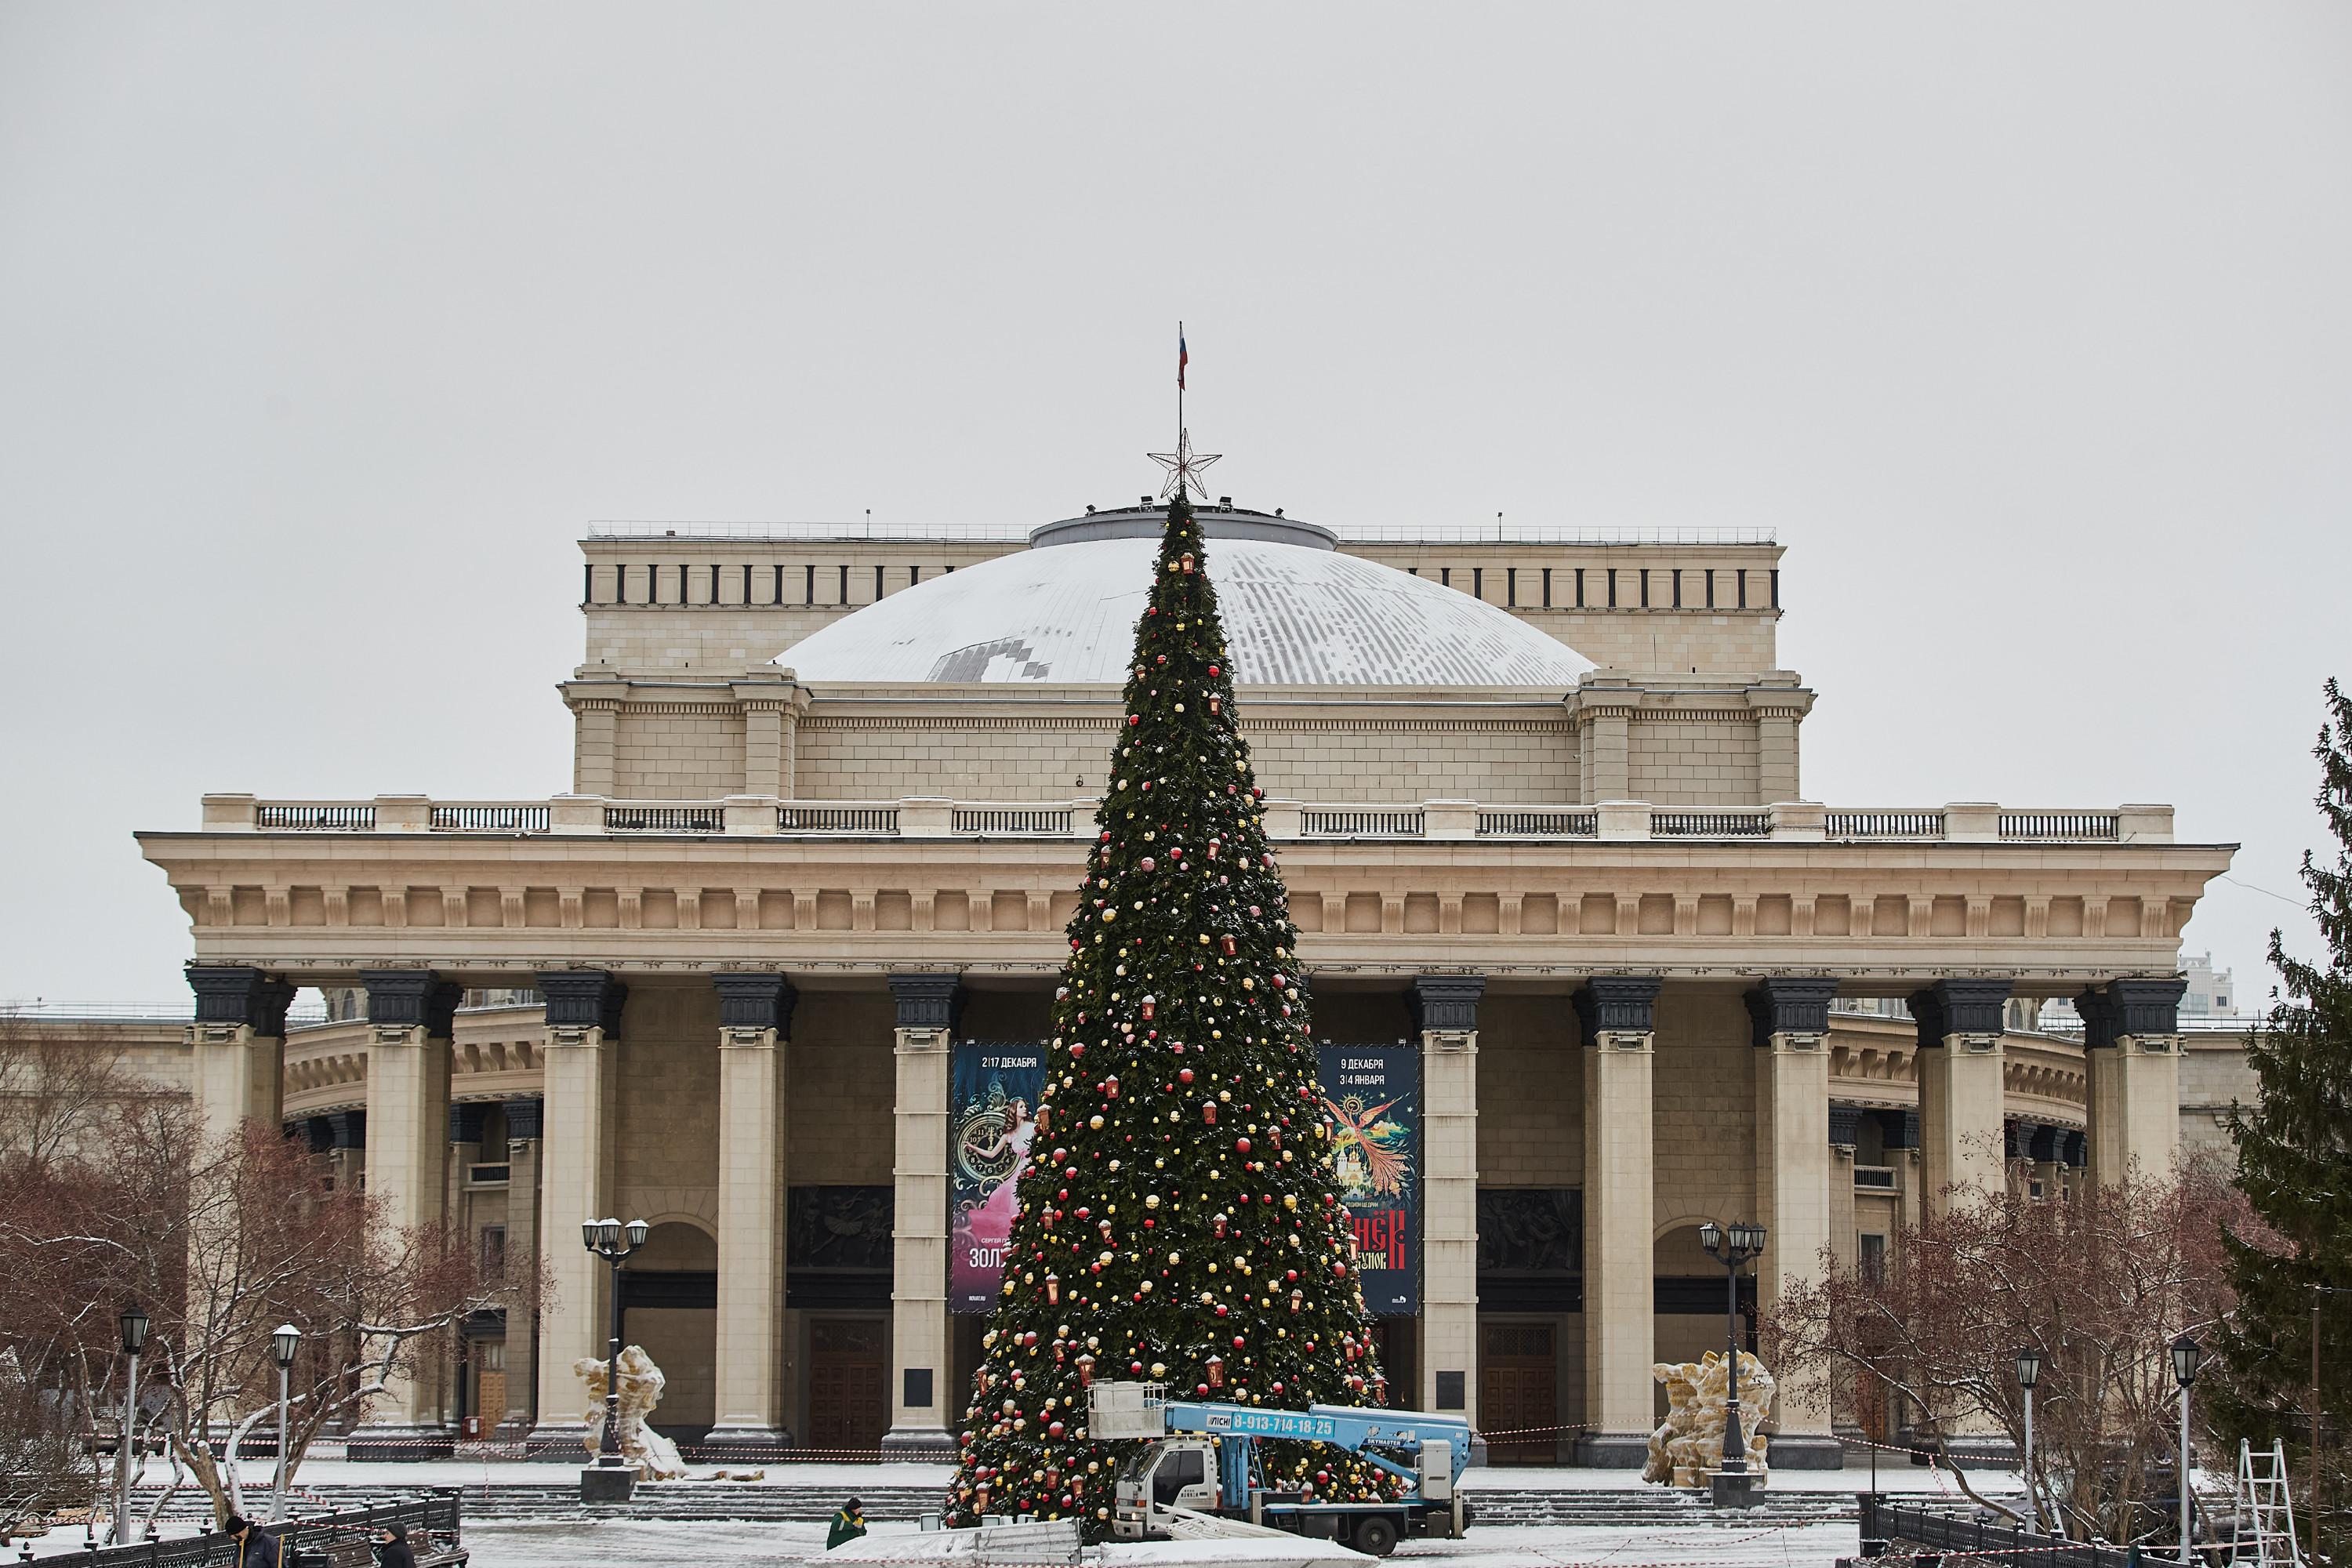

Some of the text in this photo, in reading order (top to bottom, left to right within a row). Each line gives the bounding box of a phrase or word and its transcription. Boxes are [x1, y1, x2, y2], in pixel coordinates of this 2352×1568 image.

[1001, 1057, 1036, 1069] ДЕКАБРЯ
[1341, 1058, 1384, 1070] 9 ДЕКАБРЯ
[1355, 1074, 1385, 1085] ЯНВАРЯ
[1354, 1210, 1406, 1269] НЁК
